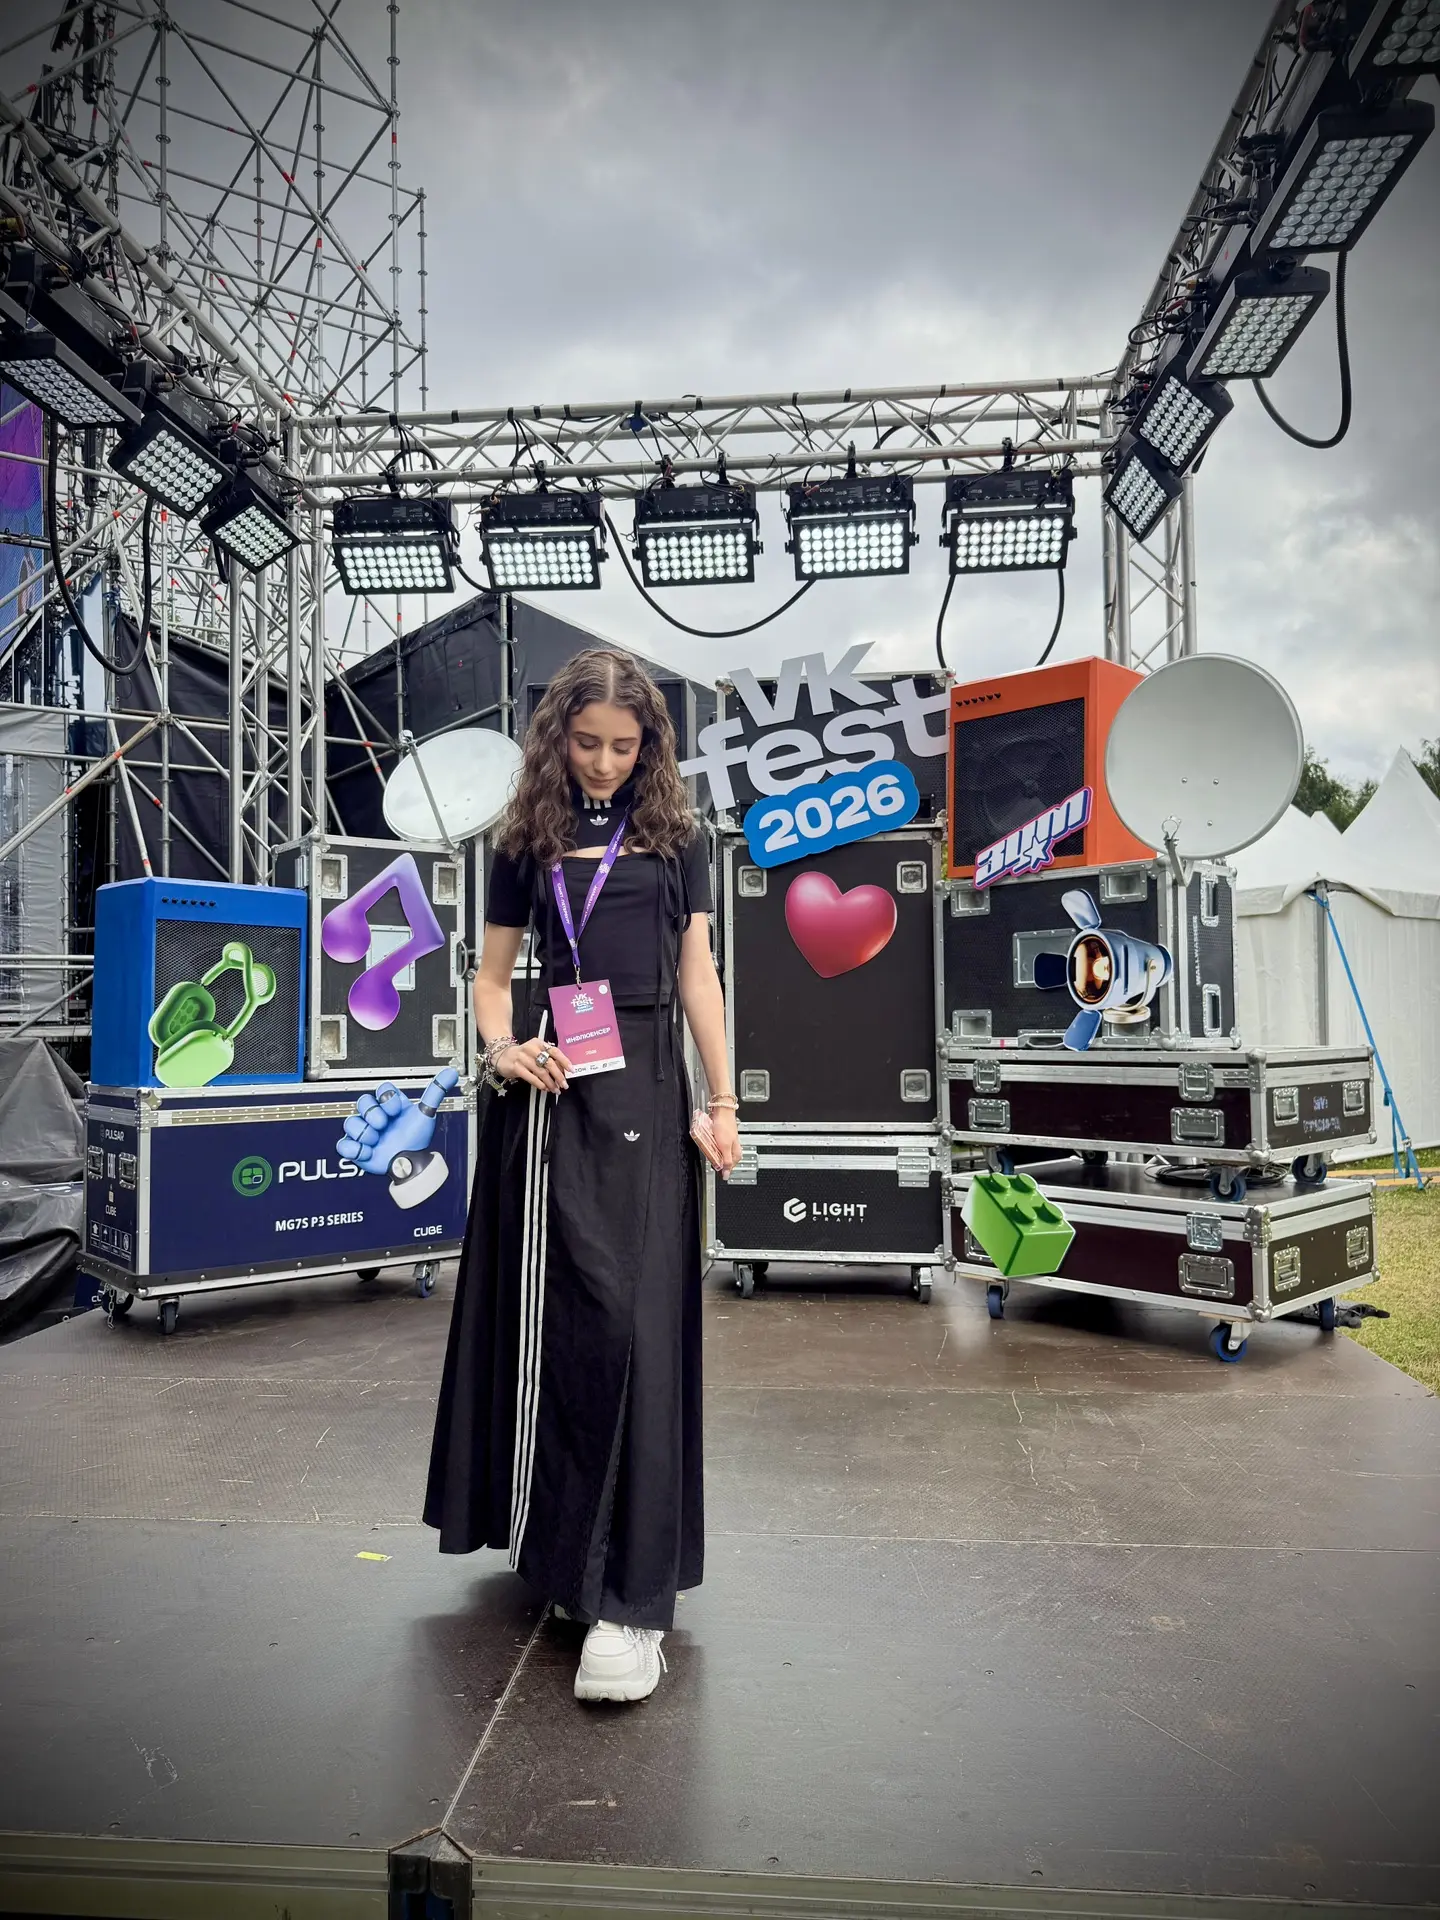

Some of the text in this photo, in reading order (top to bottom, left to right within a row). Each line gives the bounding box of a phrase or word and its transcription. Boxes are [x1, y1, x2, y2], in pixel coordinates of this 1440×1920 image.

[728, 641, 888, 727] VK
[679, 678, 951, 812] fest
[758, 773, 906, 853] 2026
[105, 1128, 125, 1142] PULSAR
[278, 1158, 367, 1184] PULS
[105, 1204, 117, 1217] CUBE
[812, 1202, 867, 1217] LIGHT
[275, 1211, 364, 1232] MG7S P3 SERIES
[413, 1225, 443, 1237] CUBE
